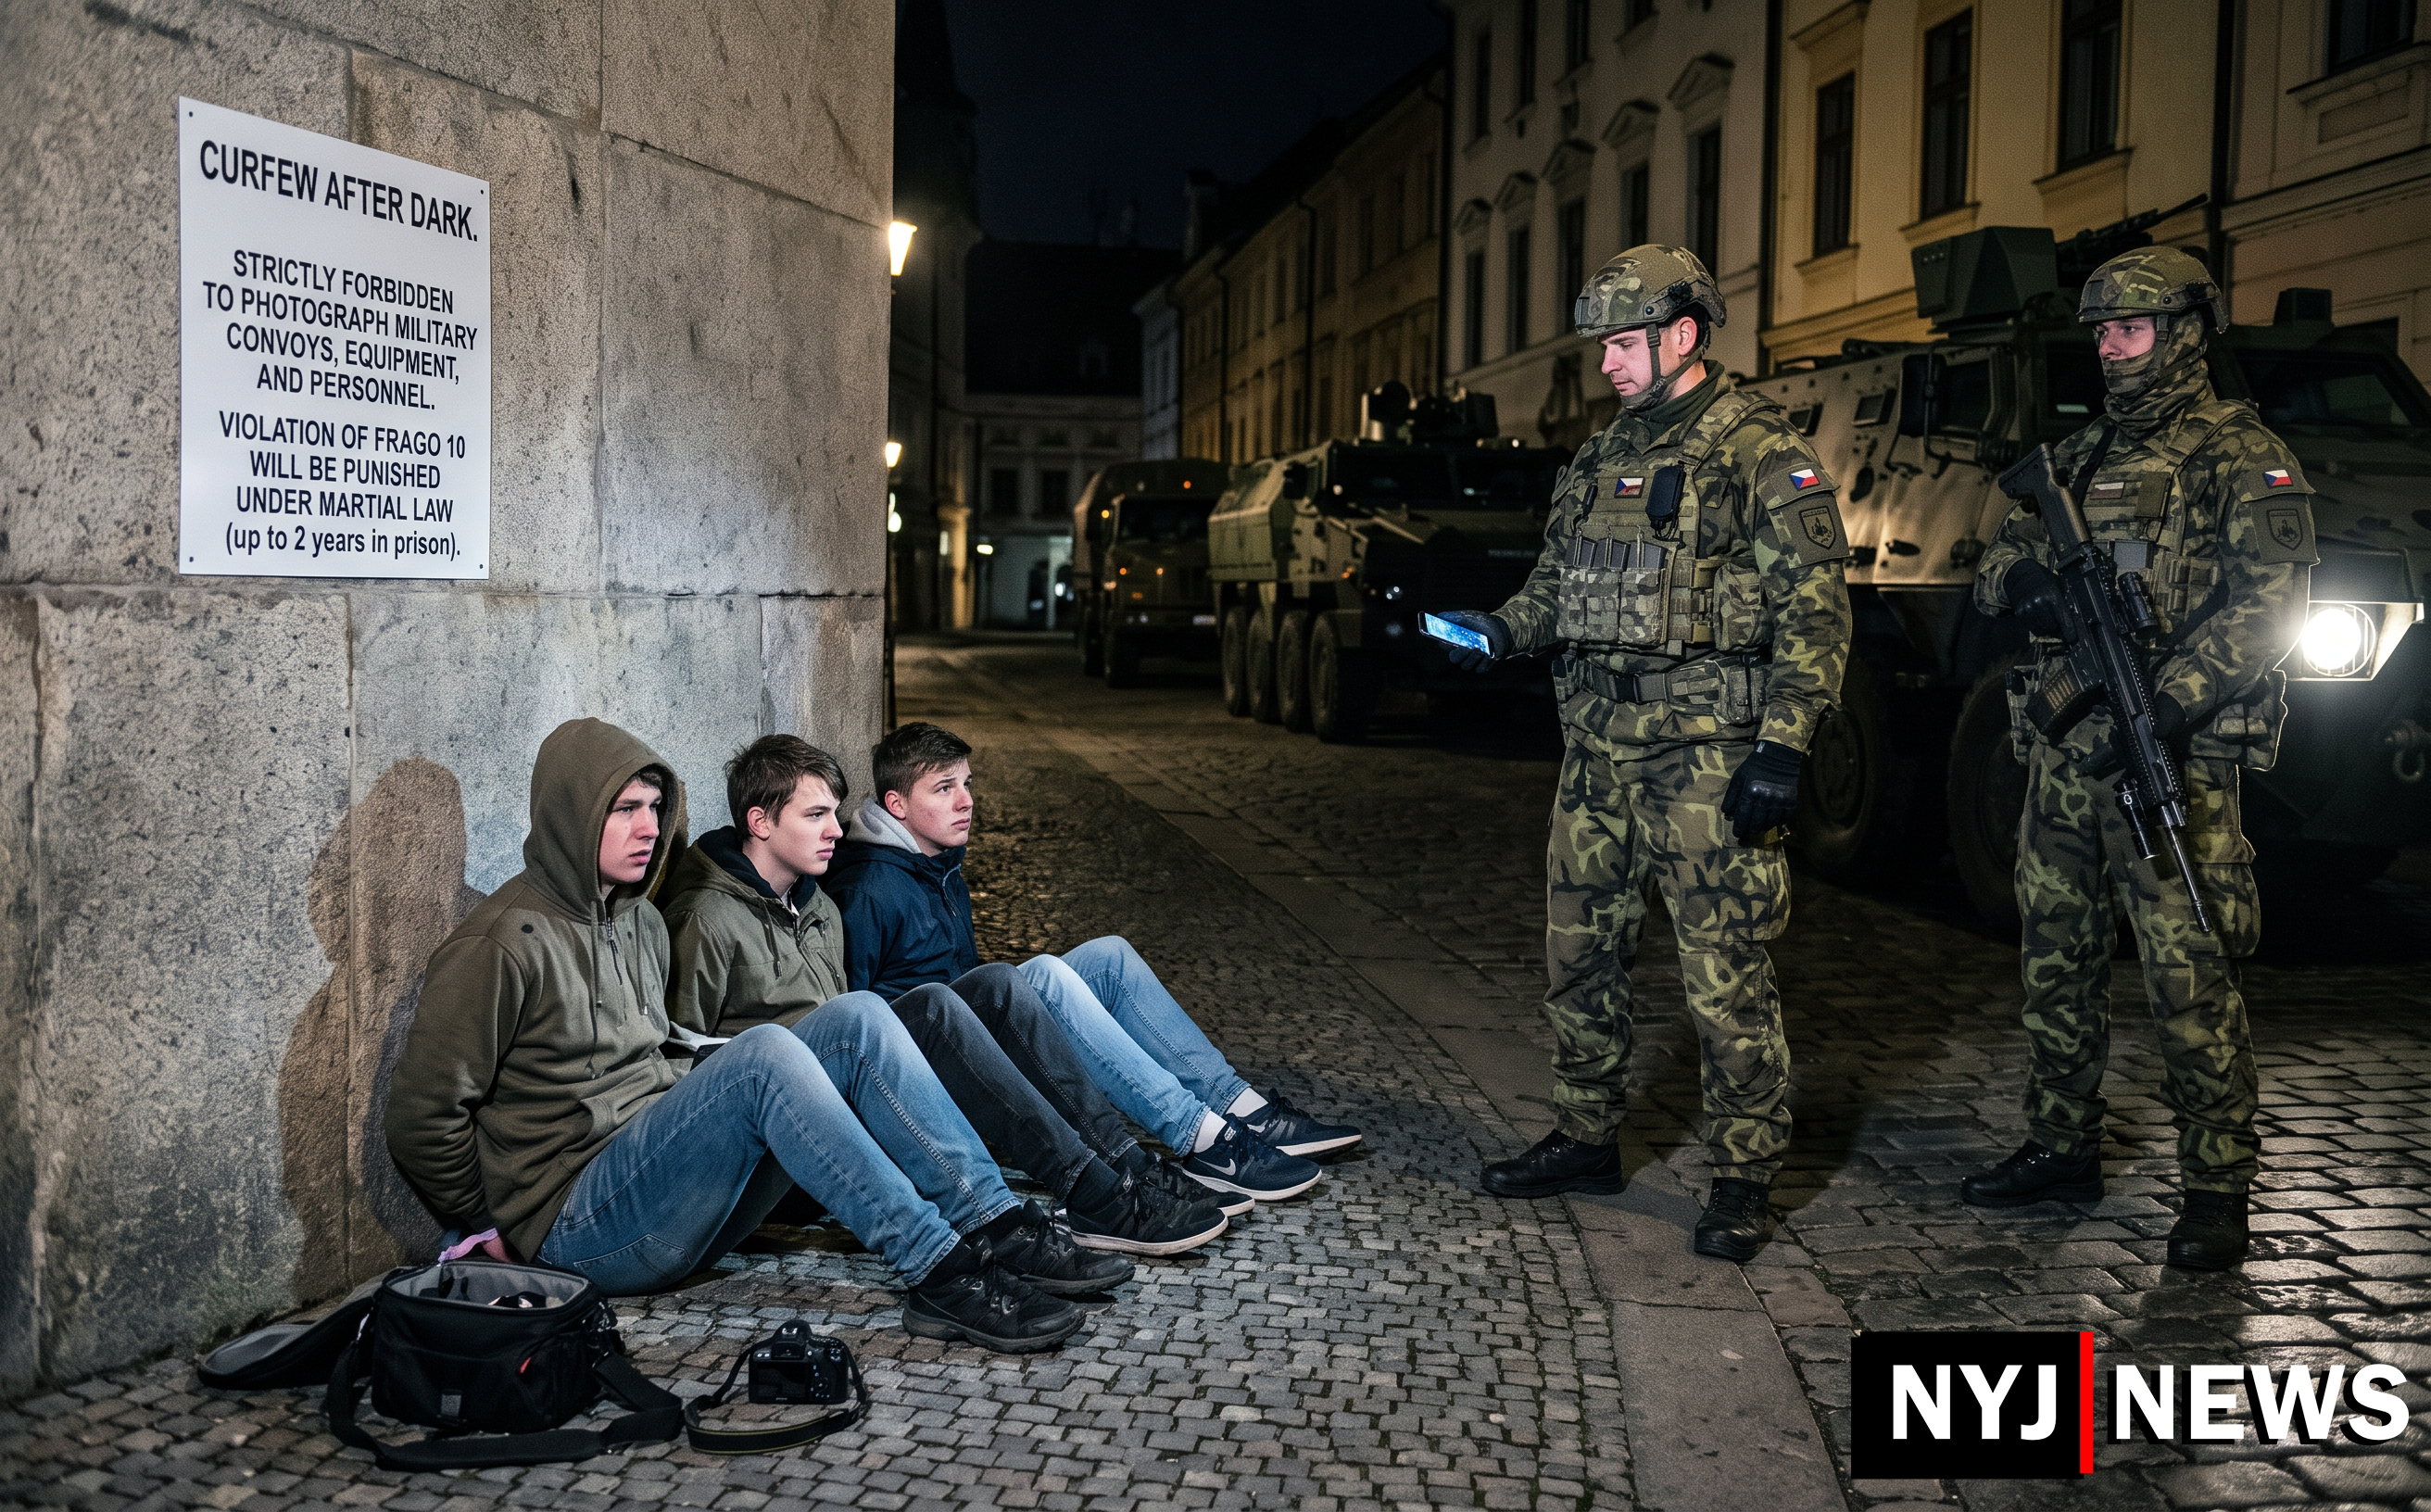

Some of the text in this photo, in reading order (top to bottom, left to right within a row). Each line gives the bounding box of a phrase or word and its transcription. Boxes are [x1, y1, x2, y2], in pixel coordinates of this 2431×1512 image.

[199, 139, 478, 243] CURFEW AFTER DARK.
[233, 249, 453, 315] STRICTLY FORBIDDEN
[202, 281, 478, 351] TO PHOTOGRAPH MILITARY
[226, 321, 460, 385] CONVOYS, EQUIPMENT,
[257, 363, 435, 410] AND PERSONNEL.
[219, 410, 466, 460] VIOLATION OF FRAGO 10
[249, 449, 441, 489] WILL BE PUNISHED
[236, 485, 454, 523] UNDER MARTIAL LAW
[226, 522, 460, 562] (up to 2 years in prison).
